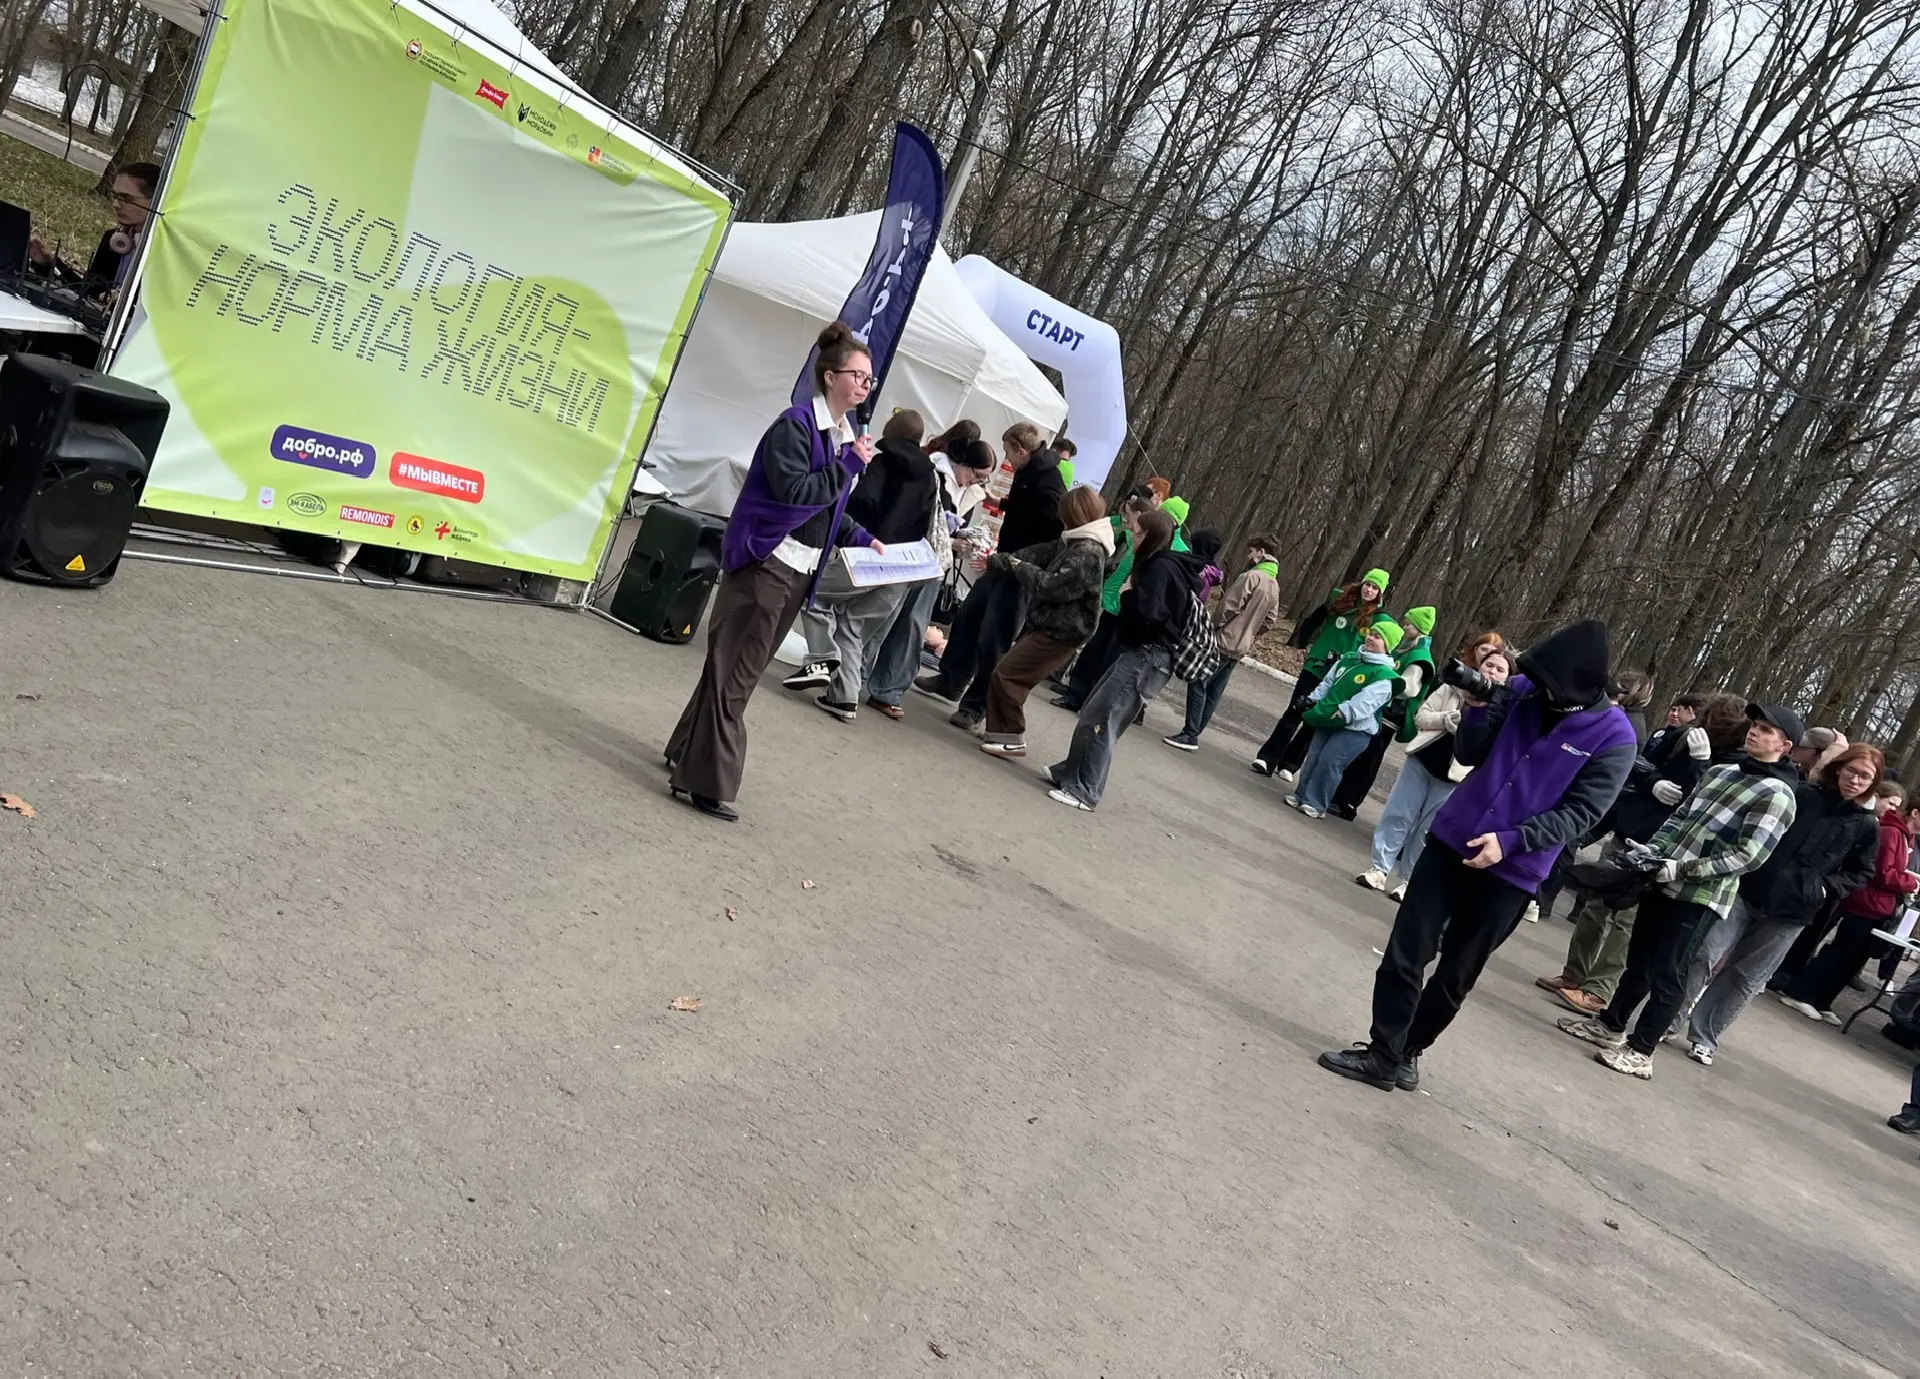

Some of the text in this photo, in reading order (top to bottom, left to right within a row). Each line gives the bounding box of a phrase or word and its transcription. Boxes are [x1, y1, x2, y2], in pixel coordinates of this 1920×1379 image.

[186, 243, 611, 433] НОРМА ЖИЗНИ
[1026, 308, 1086, 352] СТАРТ
[281, 436, 365, 468] добро.рф
[397, 462, 480, 494] #МЫВМЕСТЕ
[289, 498, 325, 512] ЭМ-КАБЕЛЬ
